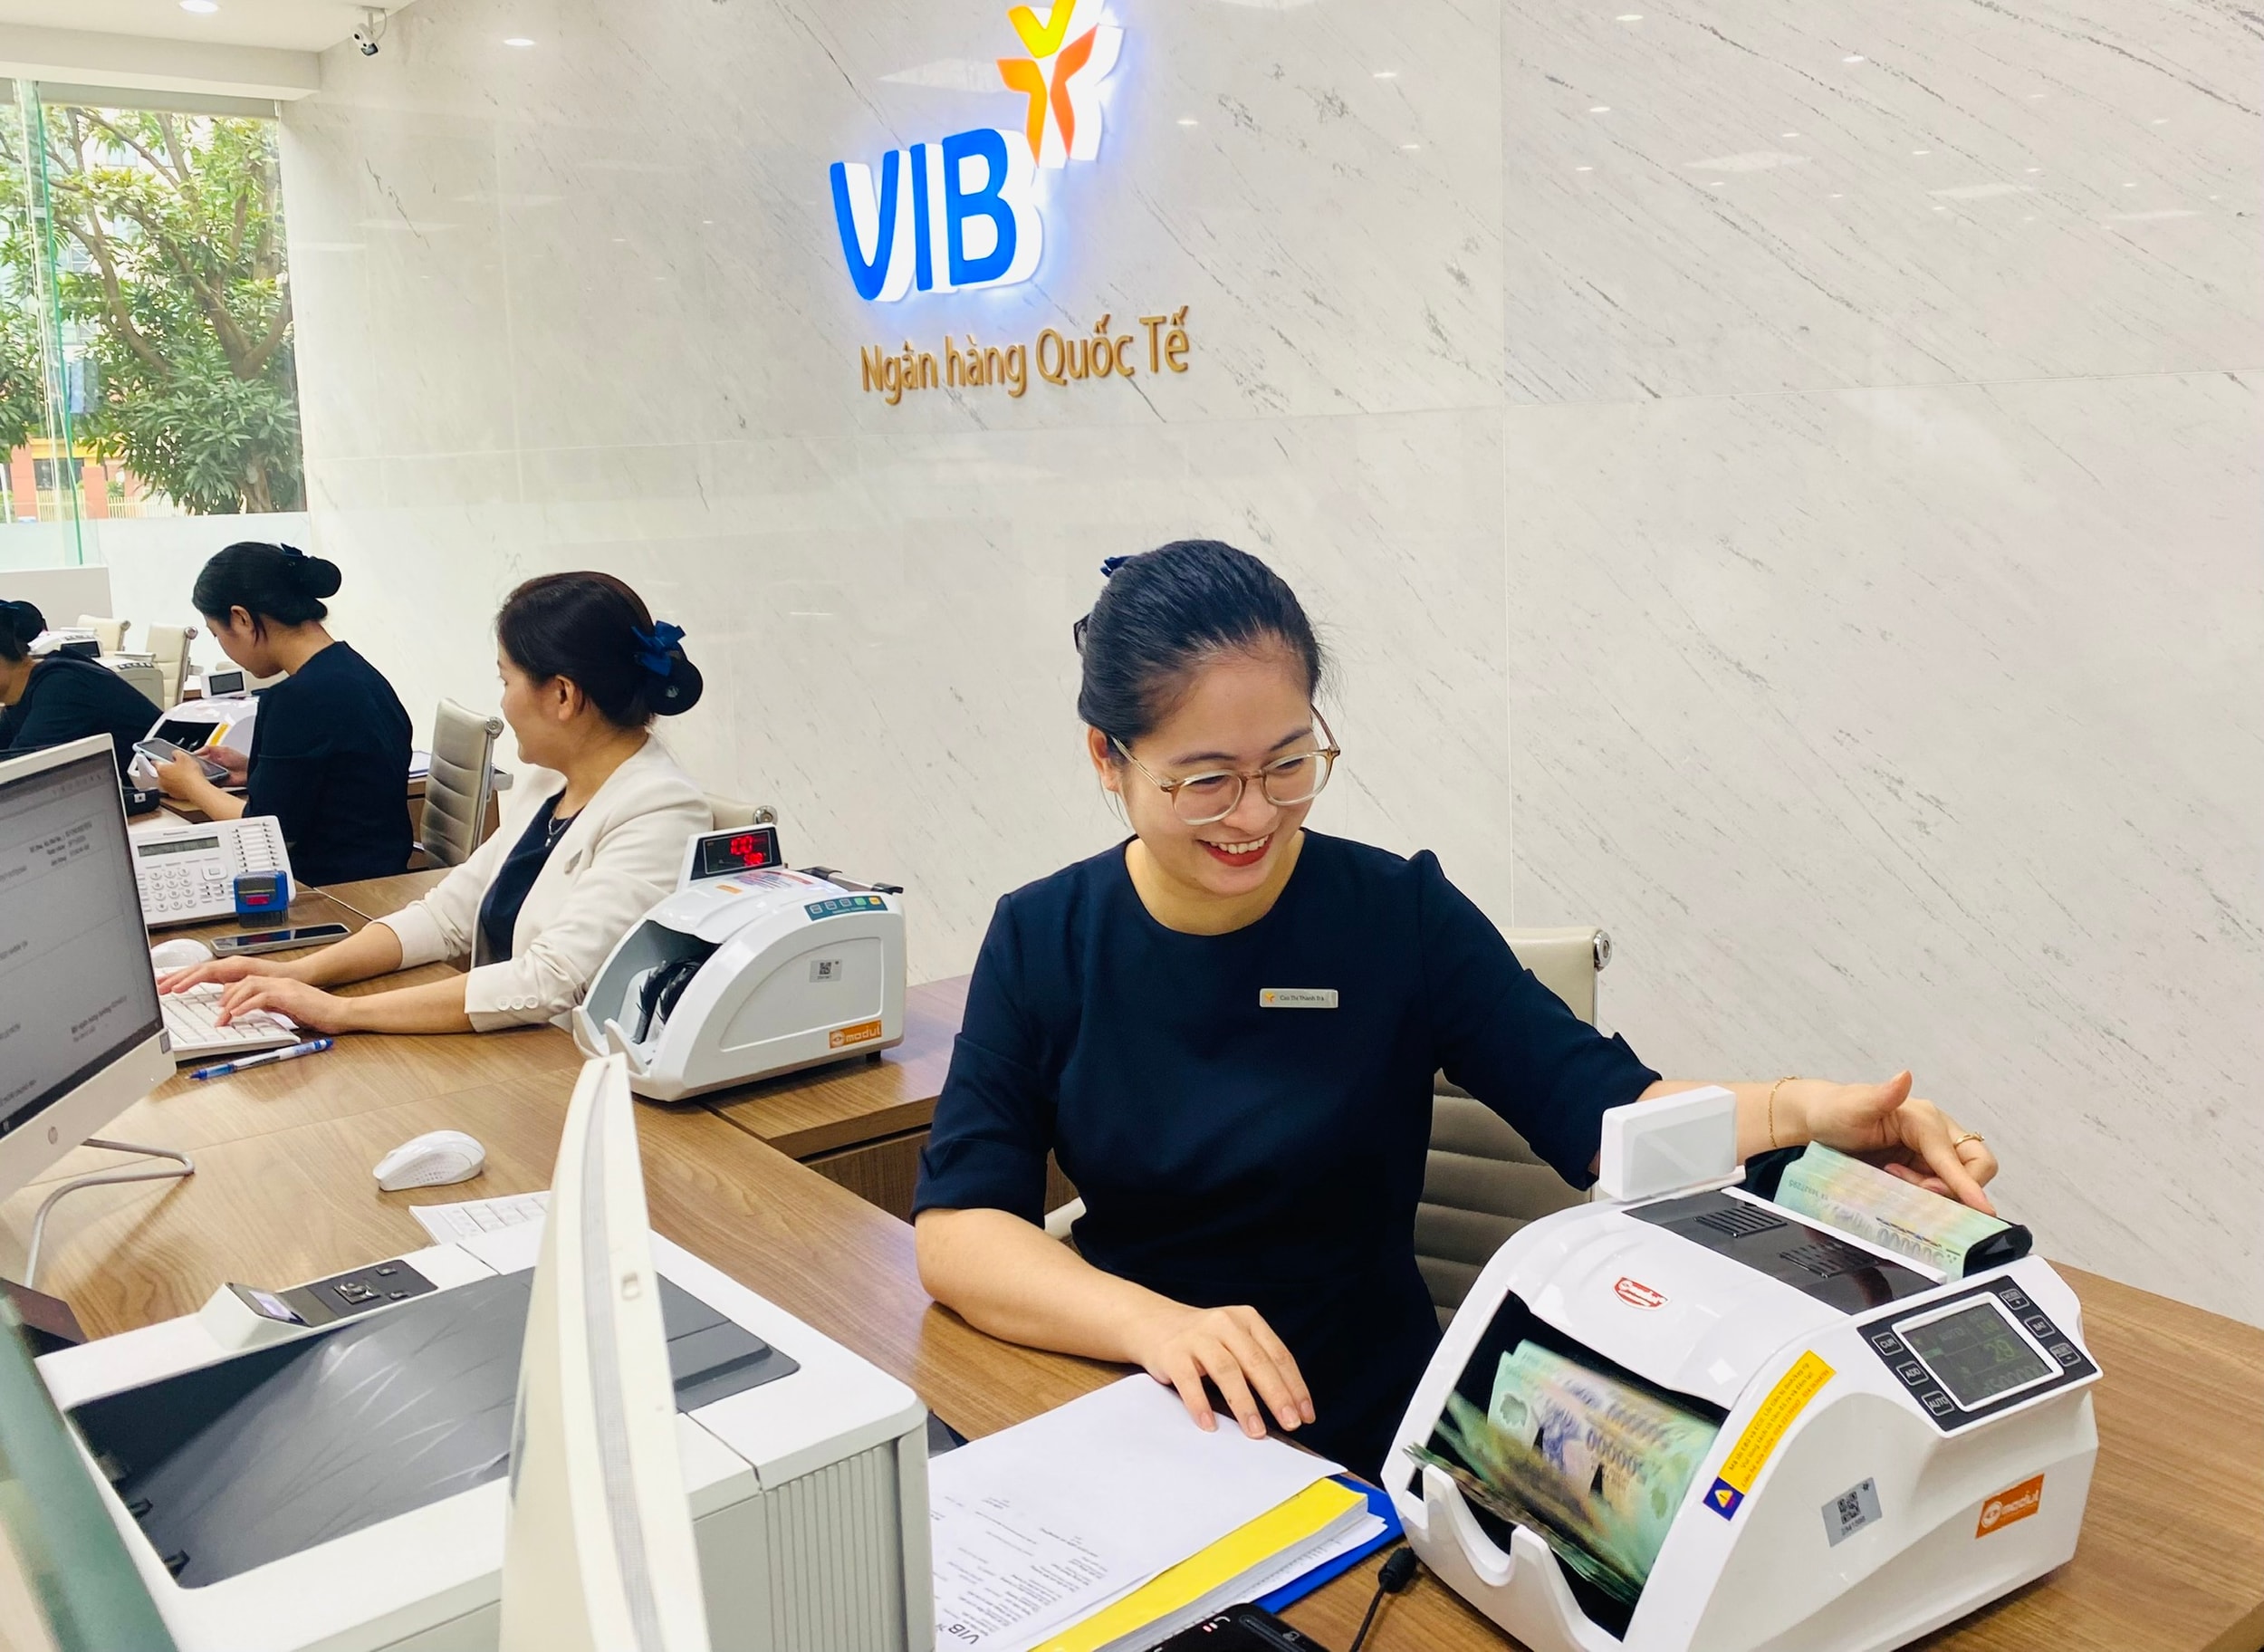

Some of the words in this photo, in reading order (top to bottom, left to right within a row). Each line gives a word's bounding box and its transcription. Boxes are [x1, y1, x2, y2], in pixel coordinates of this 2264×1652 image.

[830, 128, 1017, 301] VIB
[859, 339, 938, 406] Ngân
[944, 334, 1028, 398] hàng
[1035, 313, 1135, 389] Quốc
[1139, 305, 1191, 374] Tế
[1879, 1338, 1897, 1349] CUR
[1904, 1368, 1921, 1378] ADD
[1928, 1397, 1949, 1409] AUTO
[947, 1623, 980, 1645] VIB
